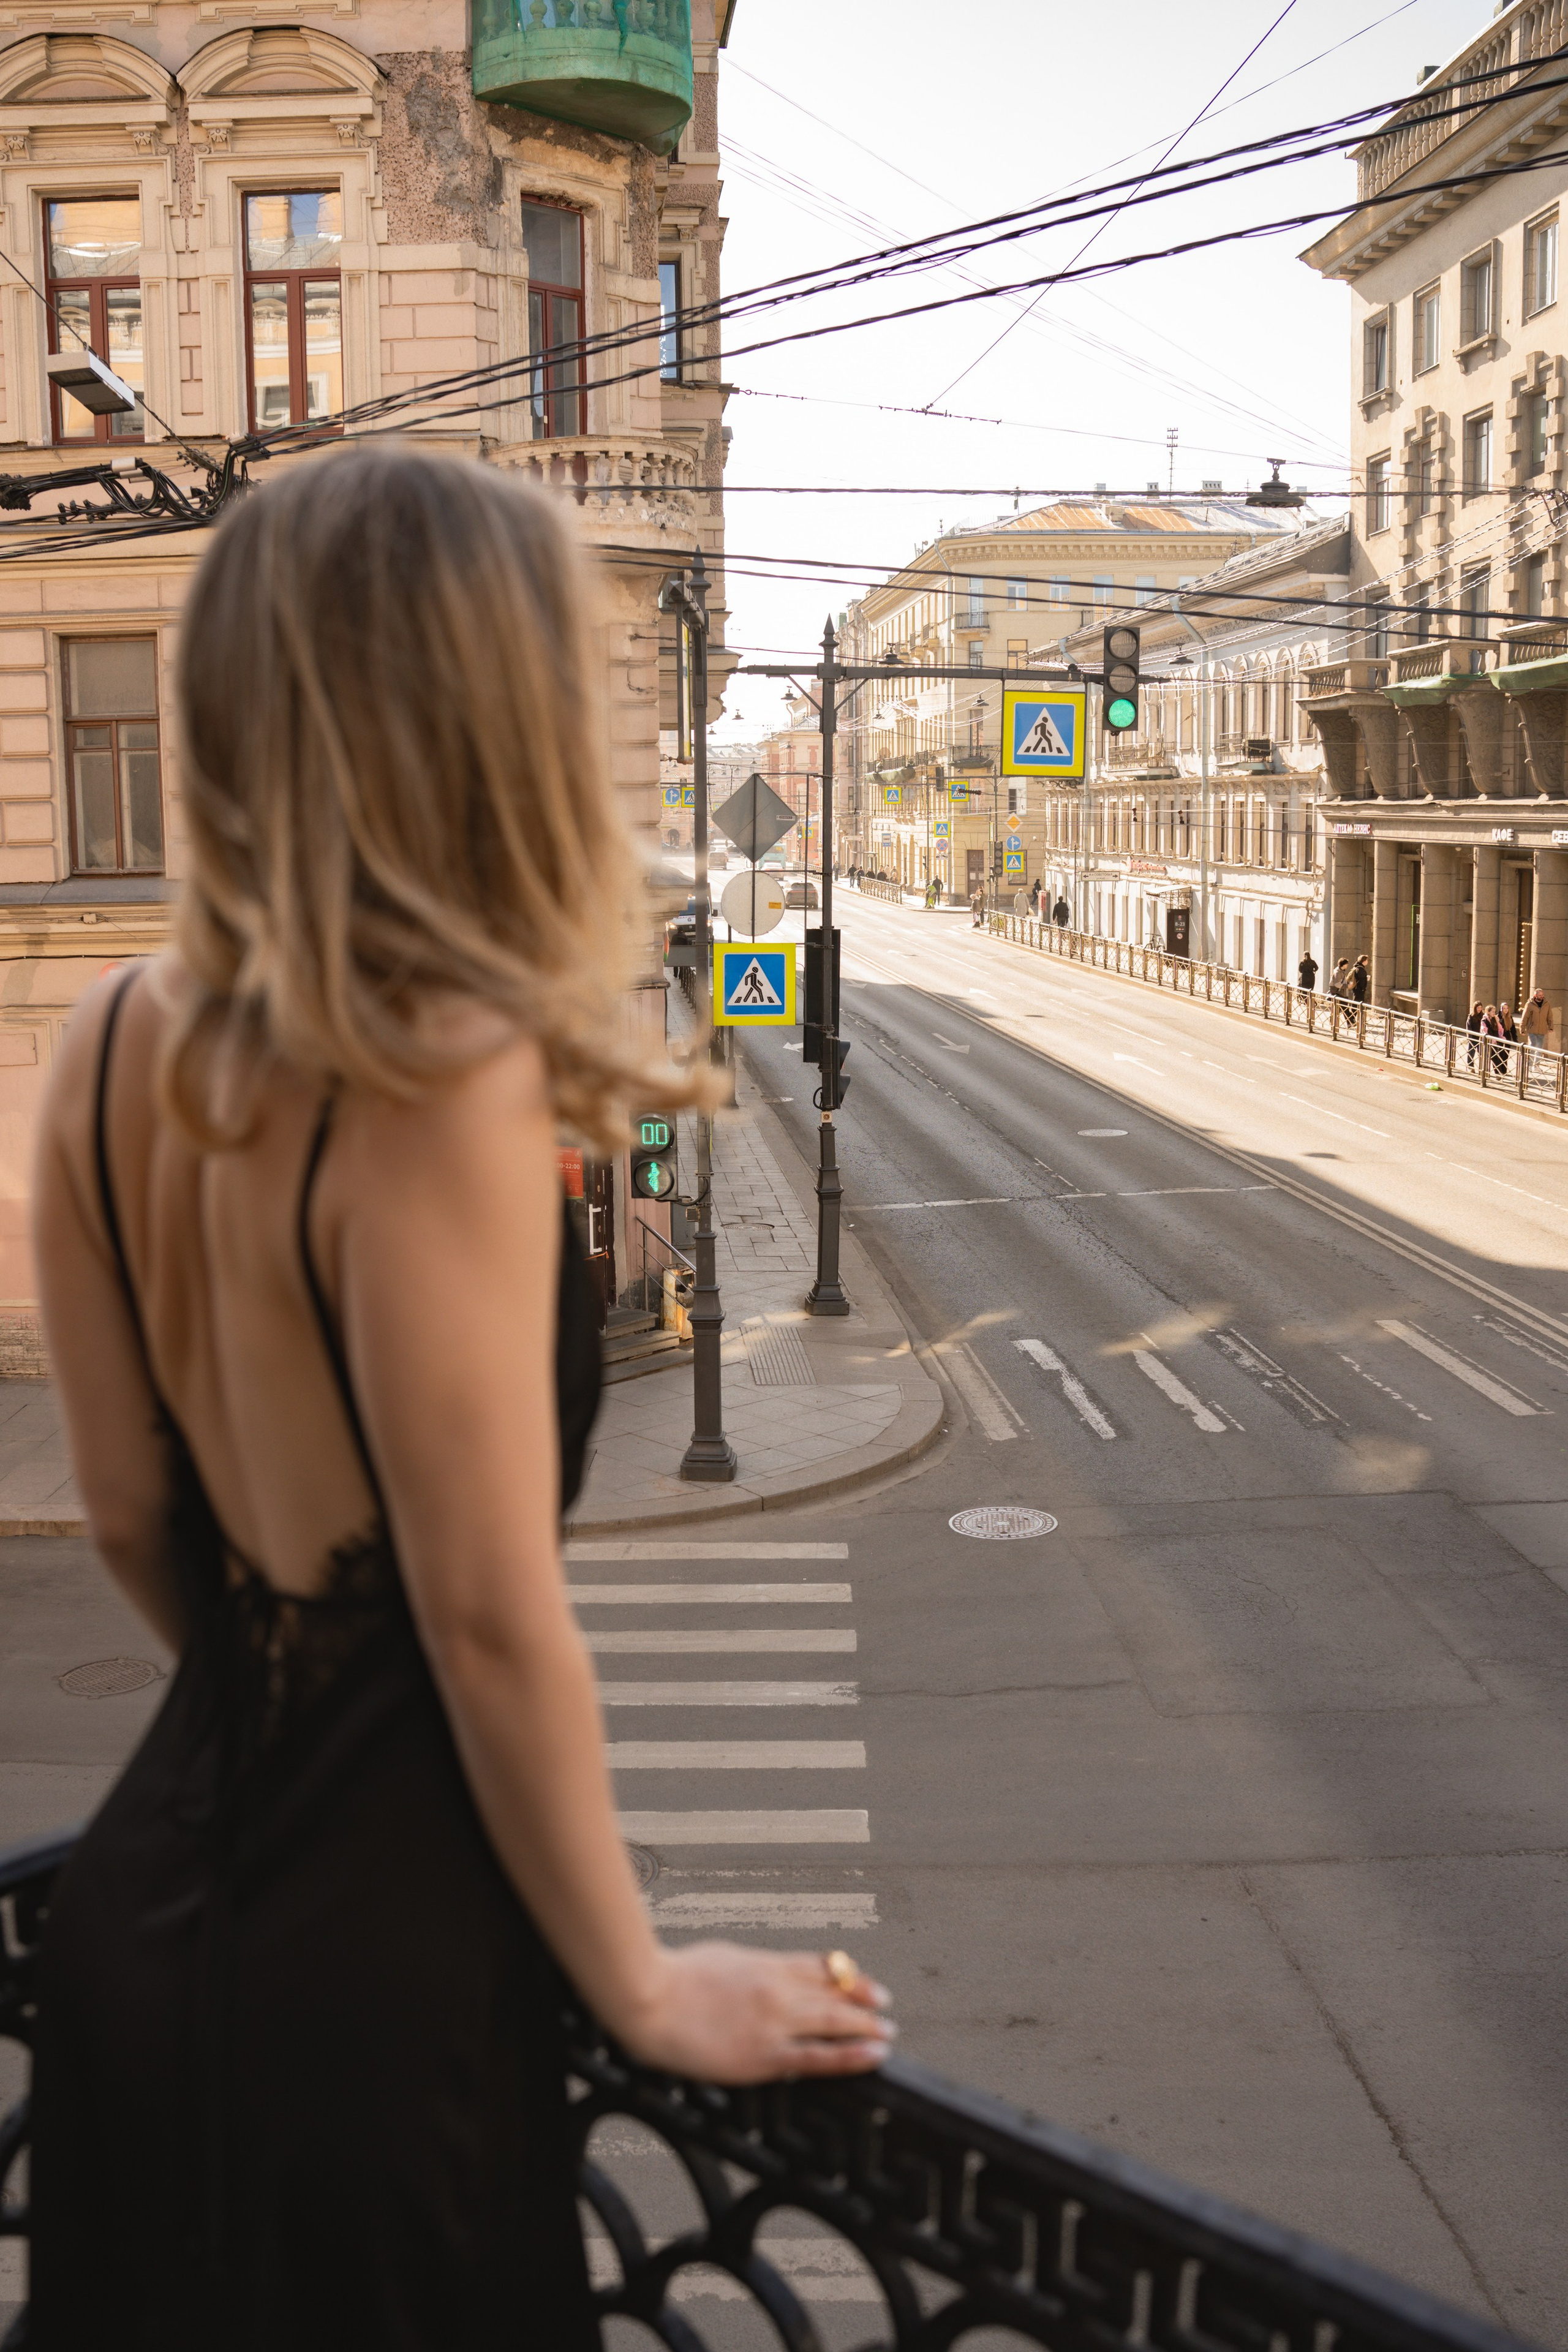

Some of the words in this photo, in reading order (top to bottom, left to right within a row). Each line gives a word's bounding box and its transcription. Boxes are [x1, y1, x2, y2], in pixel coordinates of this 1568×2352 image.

[1354, 824, 1371, 834] НЕВИС
[1492, 829, 1514, 841] КАФЕ
[642, 1123, 668, 1145] 00
